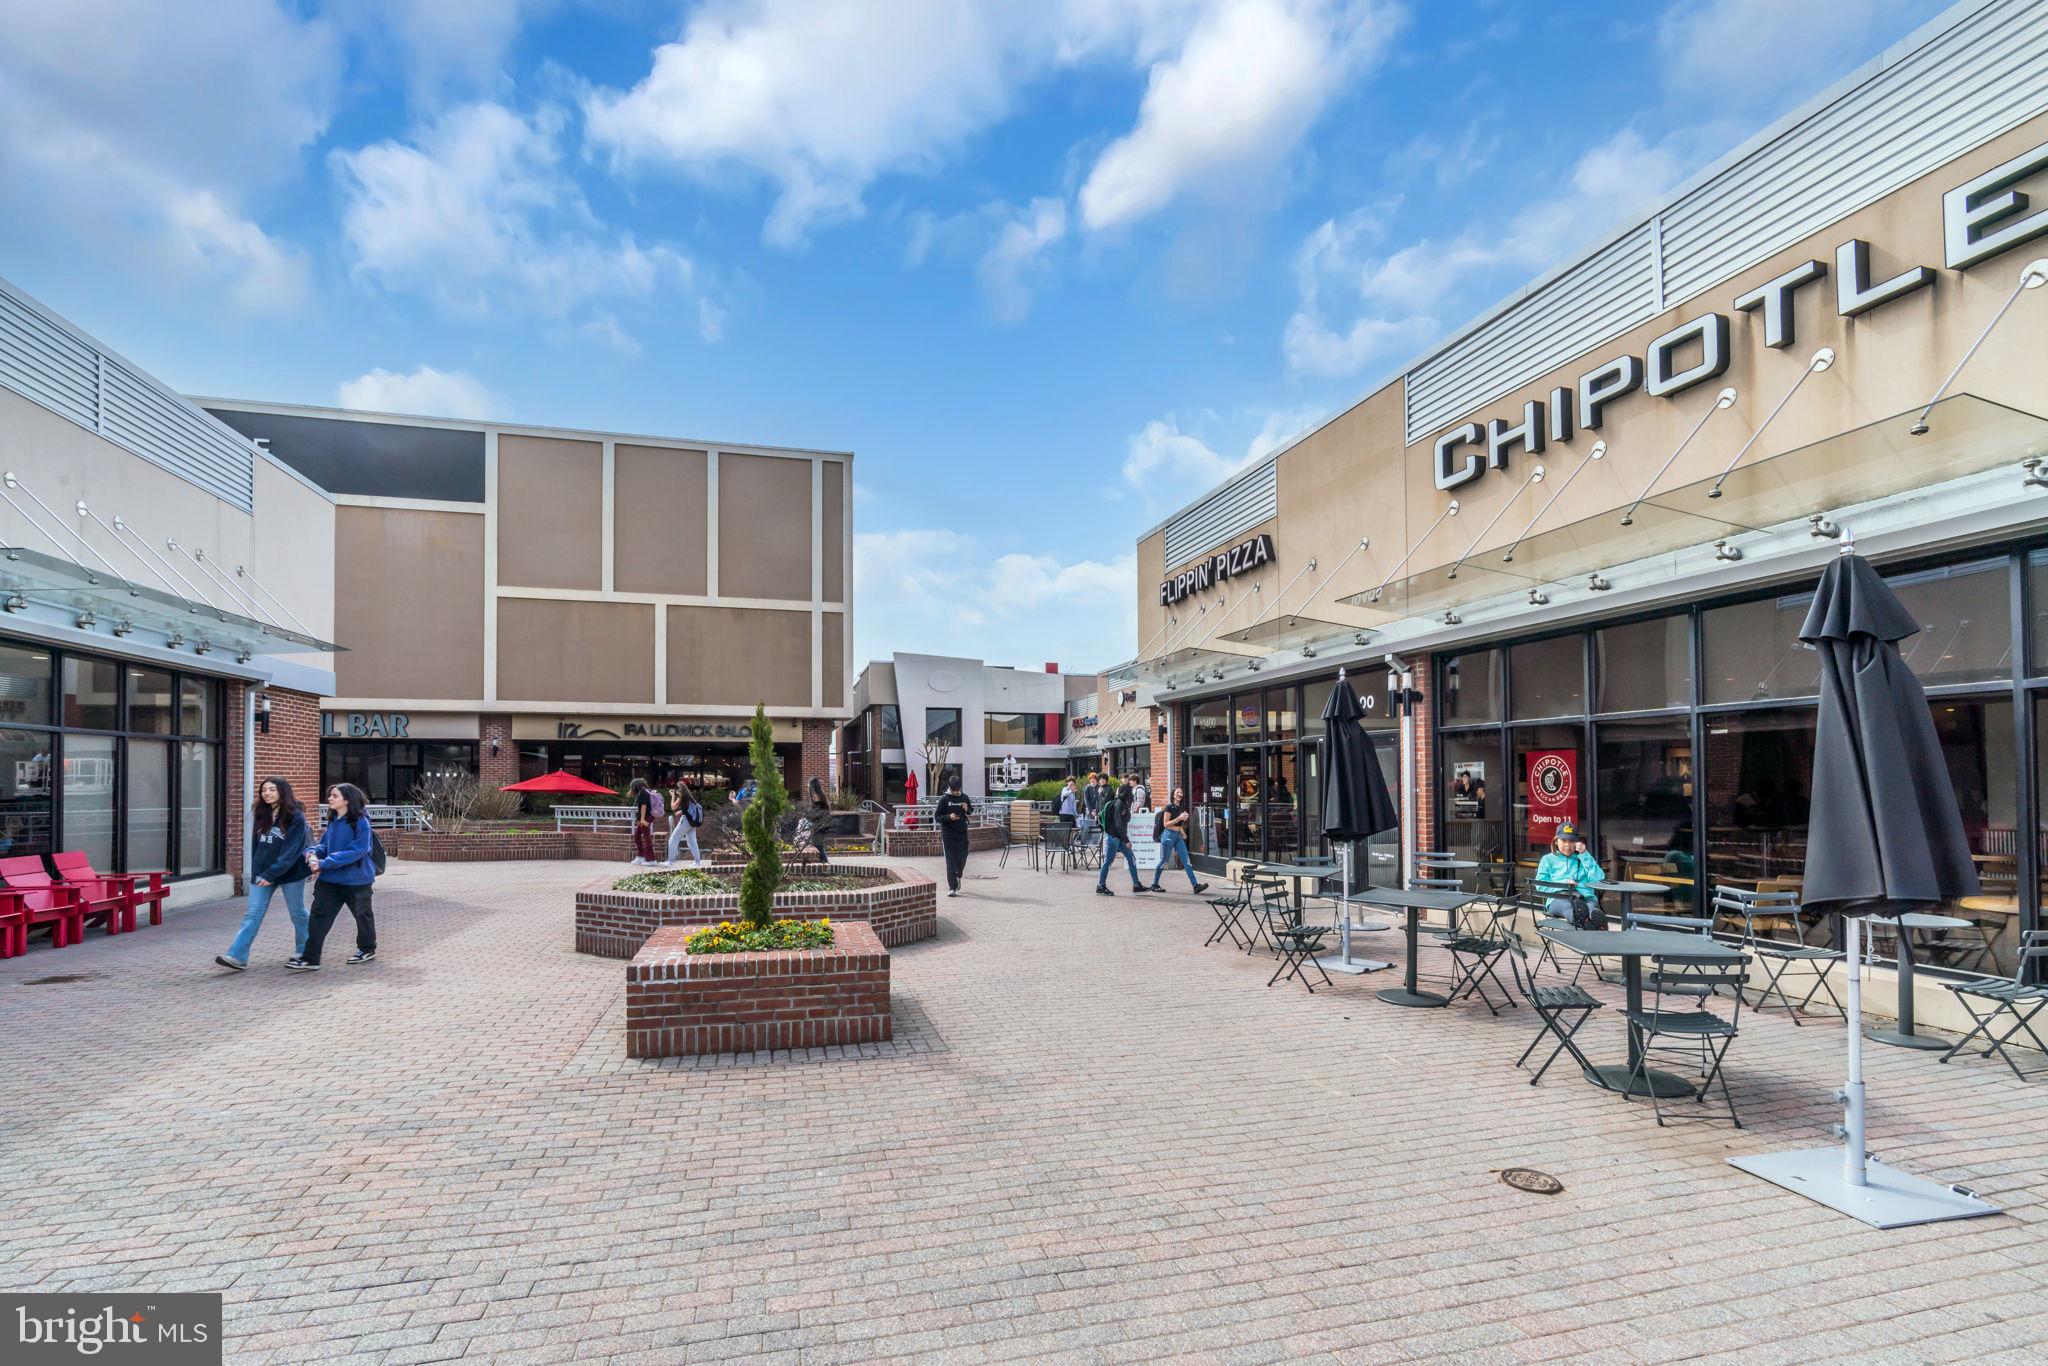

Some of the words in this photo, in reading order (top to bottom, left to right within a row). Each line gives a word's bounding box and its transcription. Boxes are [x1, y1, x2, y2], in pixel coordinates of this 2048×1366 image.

[1434, 141, 2048, 491] CHIPOTLE
[1160, 556, 1215, 607] FLIPPIN'
[1215, 534, 1275, 581] PIZZA
[348, 712, 409, 737] BAR
[624, 723, 647, 736] IRA
[650, 724, 714, 737] LUDWICK
[715, 725, 753, 738] SALO
[1534, 758, 1569, 777] CHIPOTLE
[1533, 814, 1552, 824] Open
[1553, 815, 1561, 823] to
